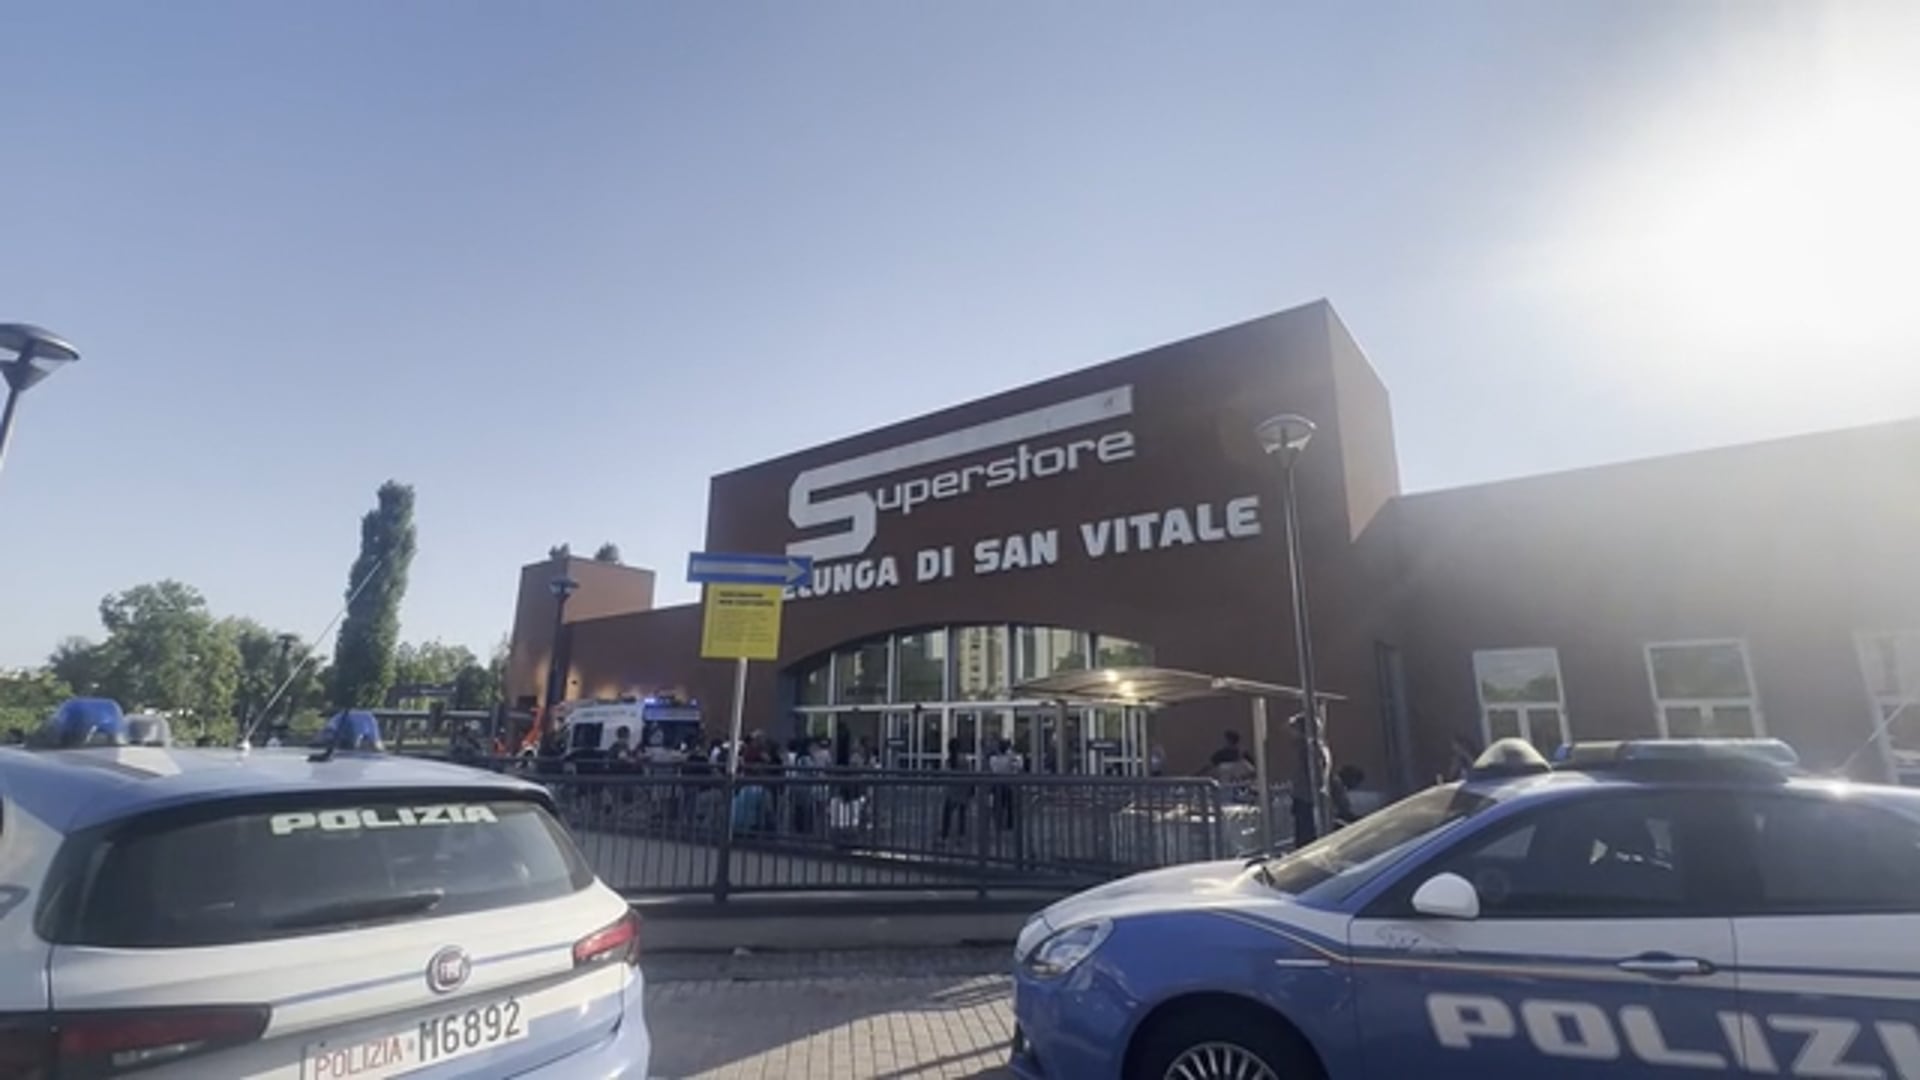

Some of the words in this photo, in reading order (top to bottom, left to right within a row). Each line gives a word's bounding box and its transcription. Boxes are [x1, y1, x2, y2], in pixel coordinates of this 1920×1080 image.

[787, 386, 1135, 560] Superstore
[918, 546, 952, 582] DI
[975, 531, 1058, 573] SAN
[1081, 497, 1260, 556] VITALE
[271, 805, 496, 835] POLIZIA
[316, 1039, 402, 1080] POLIZIA
[419, 1001, 520, 1062] M6892
